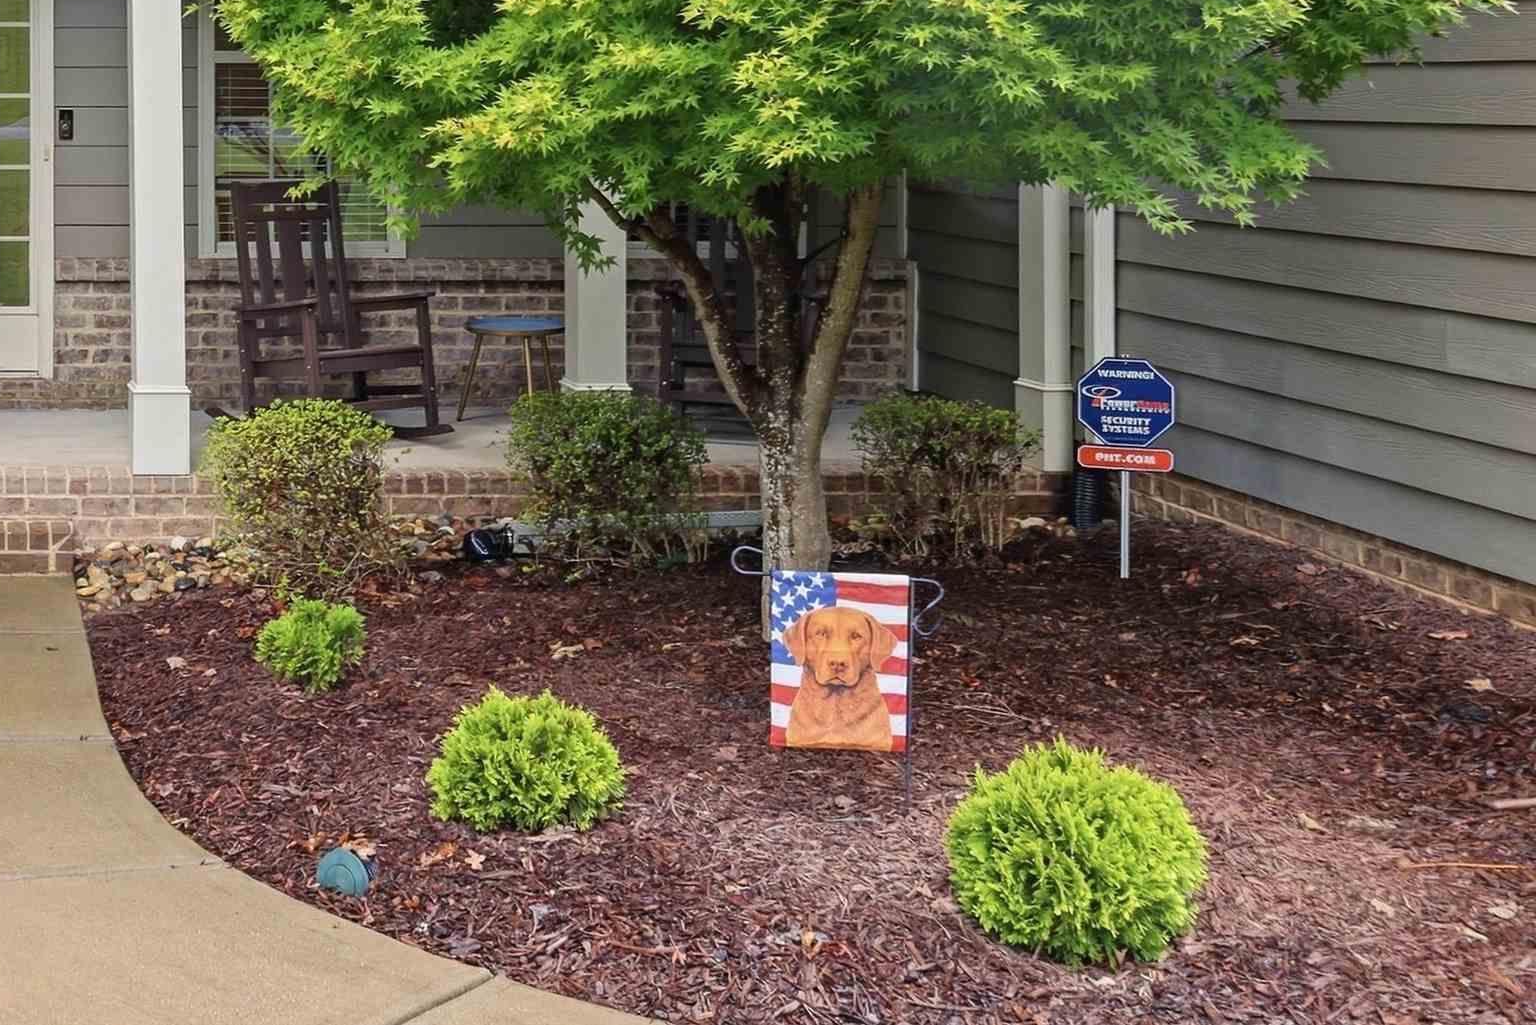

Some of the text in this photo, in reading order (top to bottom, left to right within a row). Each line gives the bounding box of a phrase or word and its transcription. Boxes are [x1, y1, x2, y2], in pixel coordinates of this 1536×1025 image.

[1096, 369, 1155, 380] WARNING!
[1100, 415, 1152, 426] SECURITY
[1101, 425, 1151, 435] SYSTEMS
